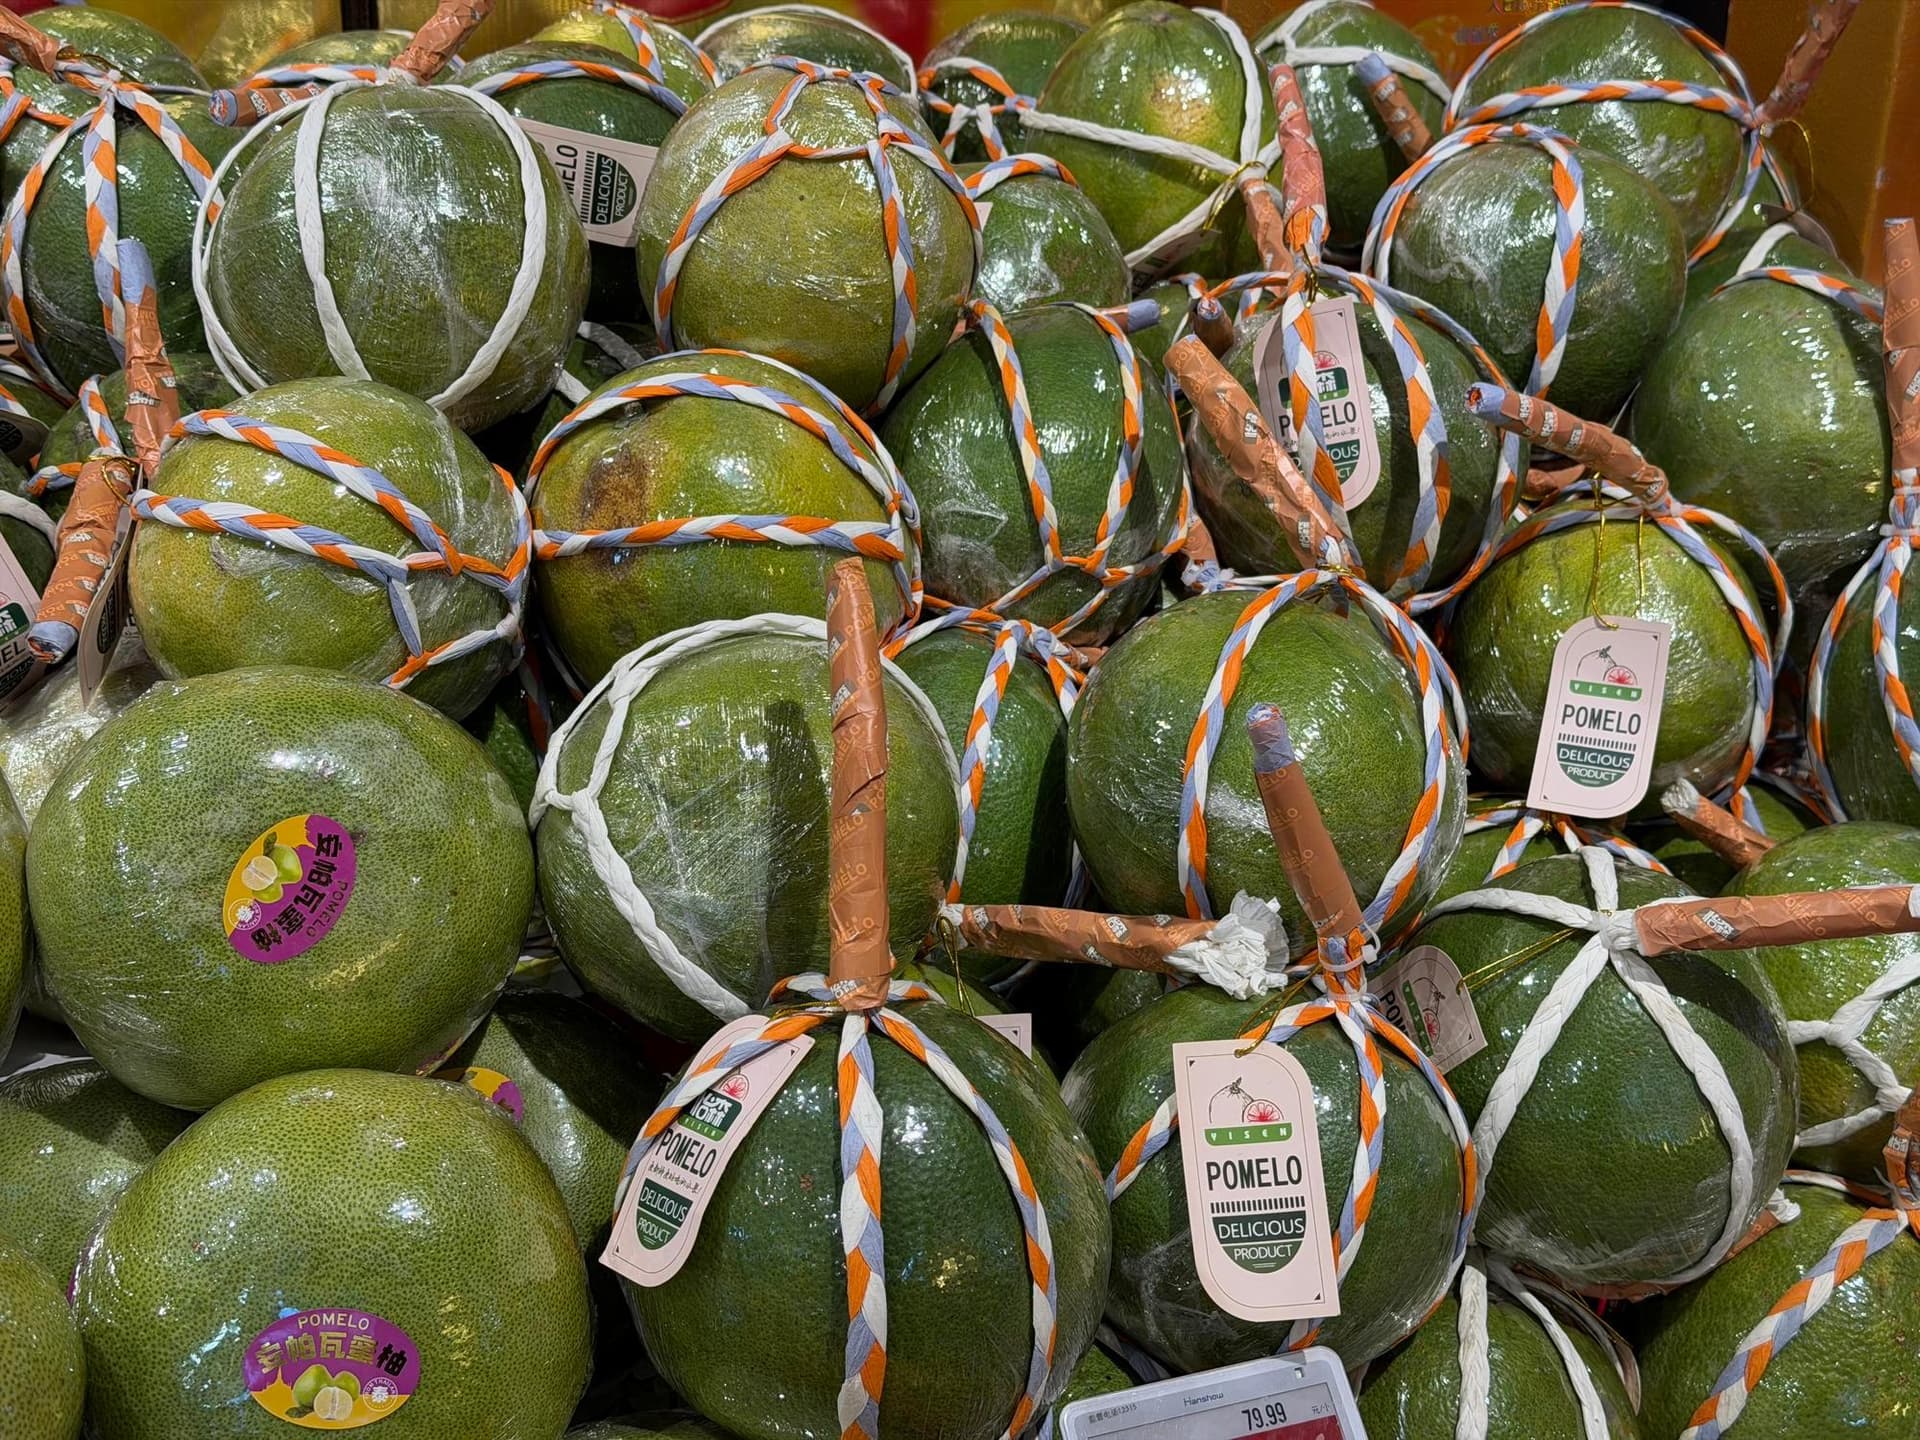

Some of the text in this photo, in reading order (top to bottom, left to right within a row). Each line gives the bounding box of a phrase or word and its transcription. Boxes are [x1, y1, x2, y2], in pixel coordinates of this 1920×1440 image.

[595, 156, 614, 224] DELICIOUS
[615, 171, 628, 217] PRODUCT
[1278, 401, 1357, 437] PELO
[1561, 704, 1642, 735] POMELO
[1559, 748, 1632, 769] DELICIOUS
[1566, 766, 1618, 782] PRODUCT
[305, 879, 349, 938] POMELO
[655, 1127, 717, 1178] POMELO
[1206, 1155, 1303, 1192] POMELO
[640, 1186, 688, 1223] DELICIOUS
[637, 1216, 672, 1245] PRODUCT
[1218, 1217, 1305, 1240] DELICIOUS
[1233, 1244, 1294, 1261] PRODUCT
[298, 1313, 370, 1331] POMELO
[255, 1331, 408, 1377] 安帕瓦蜜柚
[1184, 1391, 1224, 1407] Hanshow
[1241, 1401, 1288, 1431] 79.99
